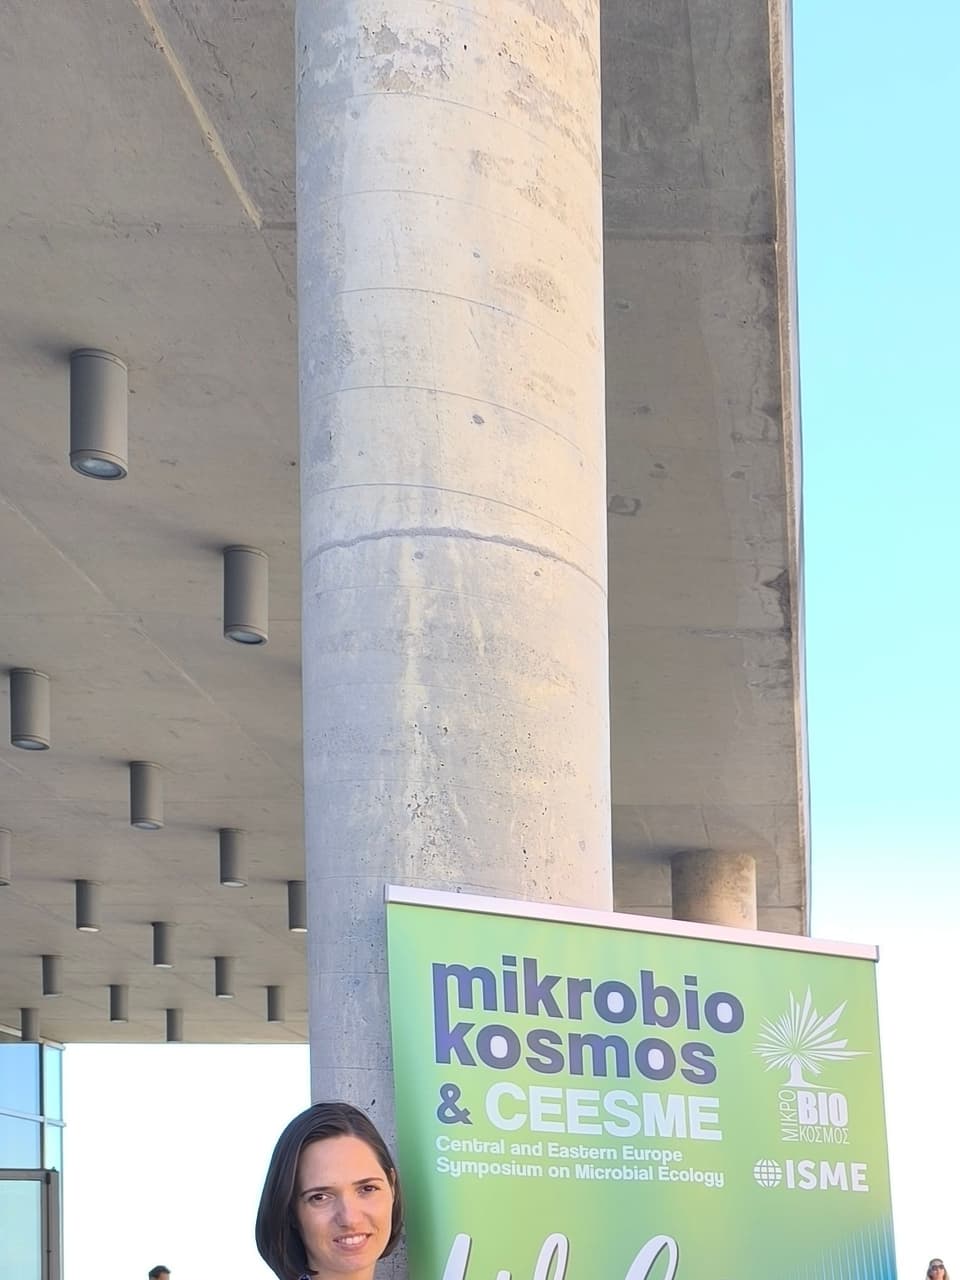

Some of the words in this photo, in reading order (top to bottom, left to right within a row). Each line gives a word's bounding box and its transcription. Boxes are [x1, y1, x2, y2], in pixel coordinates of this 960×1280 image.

[432, 954, 744, 1034] mikrobio
[434, 1022, 717, 1086] kosmos
[437, 1083, 473, 1125] &
[485, 1082, 723, 1141] CEESME
[435, 1135, 505, 1155] Central
[511, 1140, 543, 1157] and
[548, 1142, 617, 1161] Eastern
[622, 1145, 683, 1165] Europe
[799, 1126, 850, 1144] ΚΟΣΜΟΣ
[436, 1157, 543, 1178] Symposium
[549, 1165, 570, 1179] on
[575, 1163, 653, 1181] Microbial
[658, 1166, 725, 1188] Ecology
[785, 1159, 870, 1192] ISME
